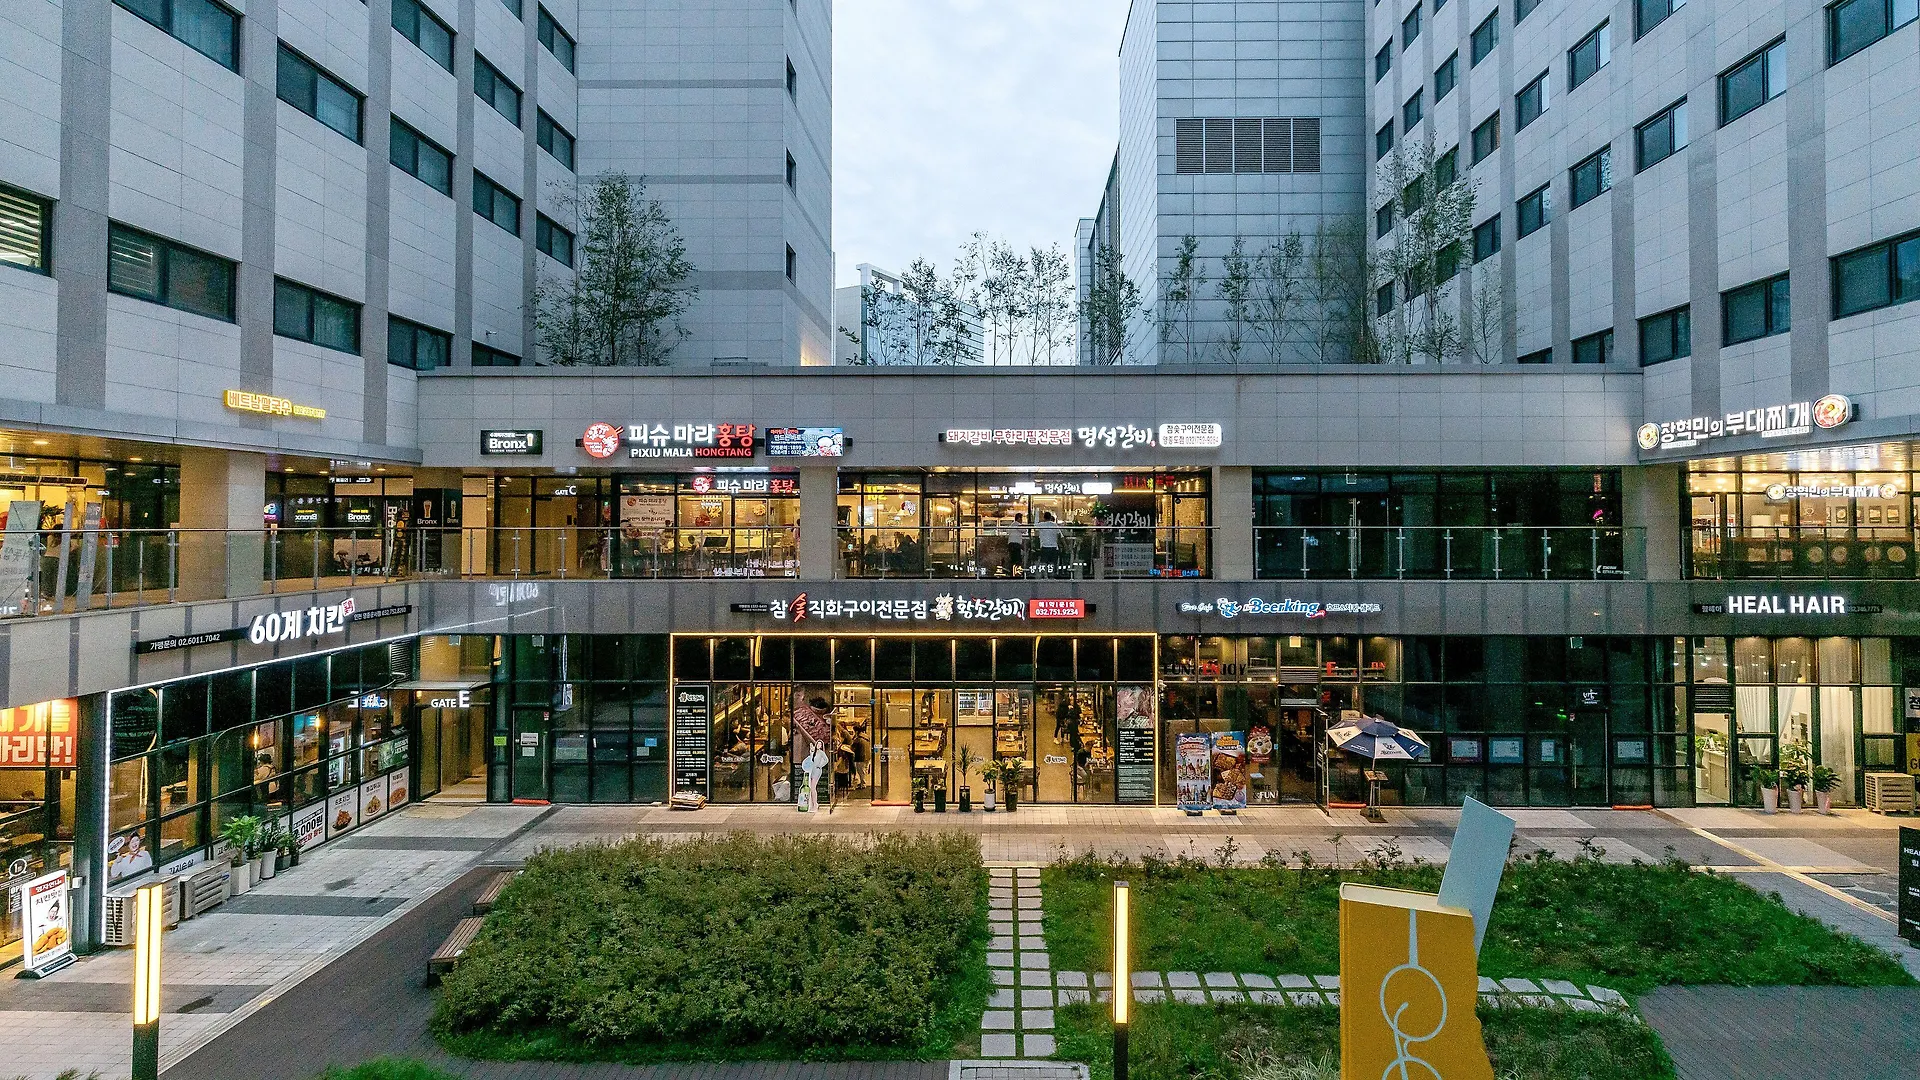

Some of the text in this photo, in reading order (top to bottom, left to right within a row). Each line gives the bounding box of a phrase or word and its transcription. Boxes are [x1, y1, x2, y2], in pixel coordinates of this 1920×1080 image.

[229, 391, 292, 415] 베트남쌀국수
[1725, 401, 1811, 435] 부대찌개
[490, 438, 527, 449] Bronx
[947, 430, 1072, 445] 돼지갈비 무한리필전문점
[1077, 424, 1153, 449] 명성갈비
[631, 448, 752, 458] PIXIU MALA HONGTANG
[569, 485, 577, 495] C
[348, 513, 371, 521] Bronx
[1035, 609, 1079, 617] 032.751.9234
[1250, 598, 1319, 617] Beerking
[1728, 596, 1846, 613] HEAL HAIR
[250, 609, 302, 645] 60계
[306, 604, 345, 637] 치킨
[150, 633, 220, 651] 가맹문의 02.6011.7042
[431, 690, 470, 708] GATE E
